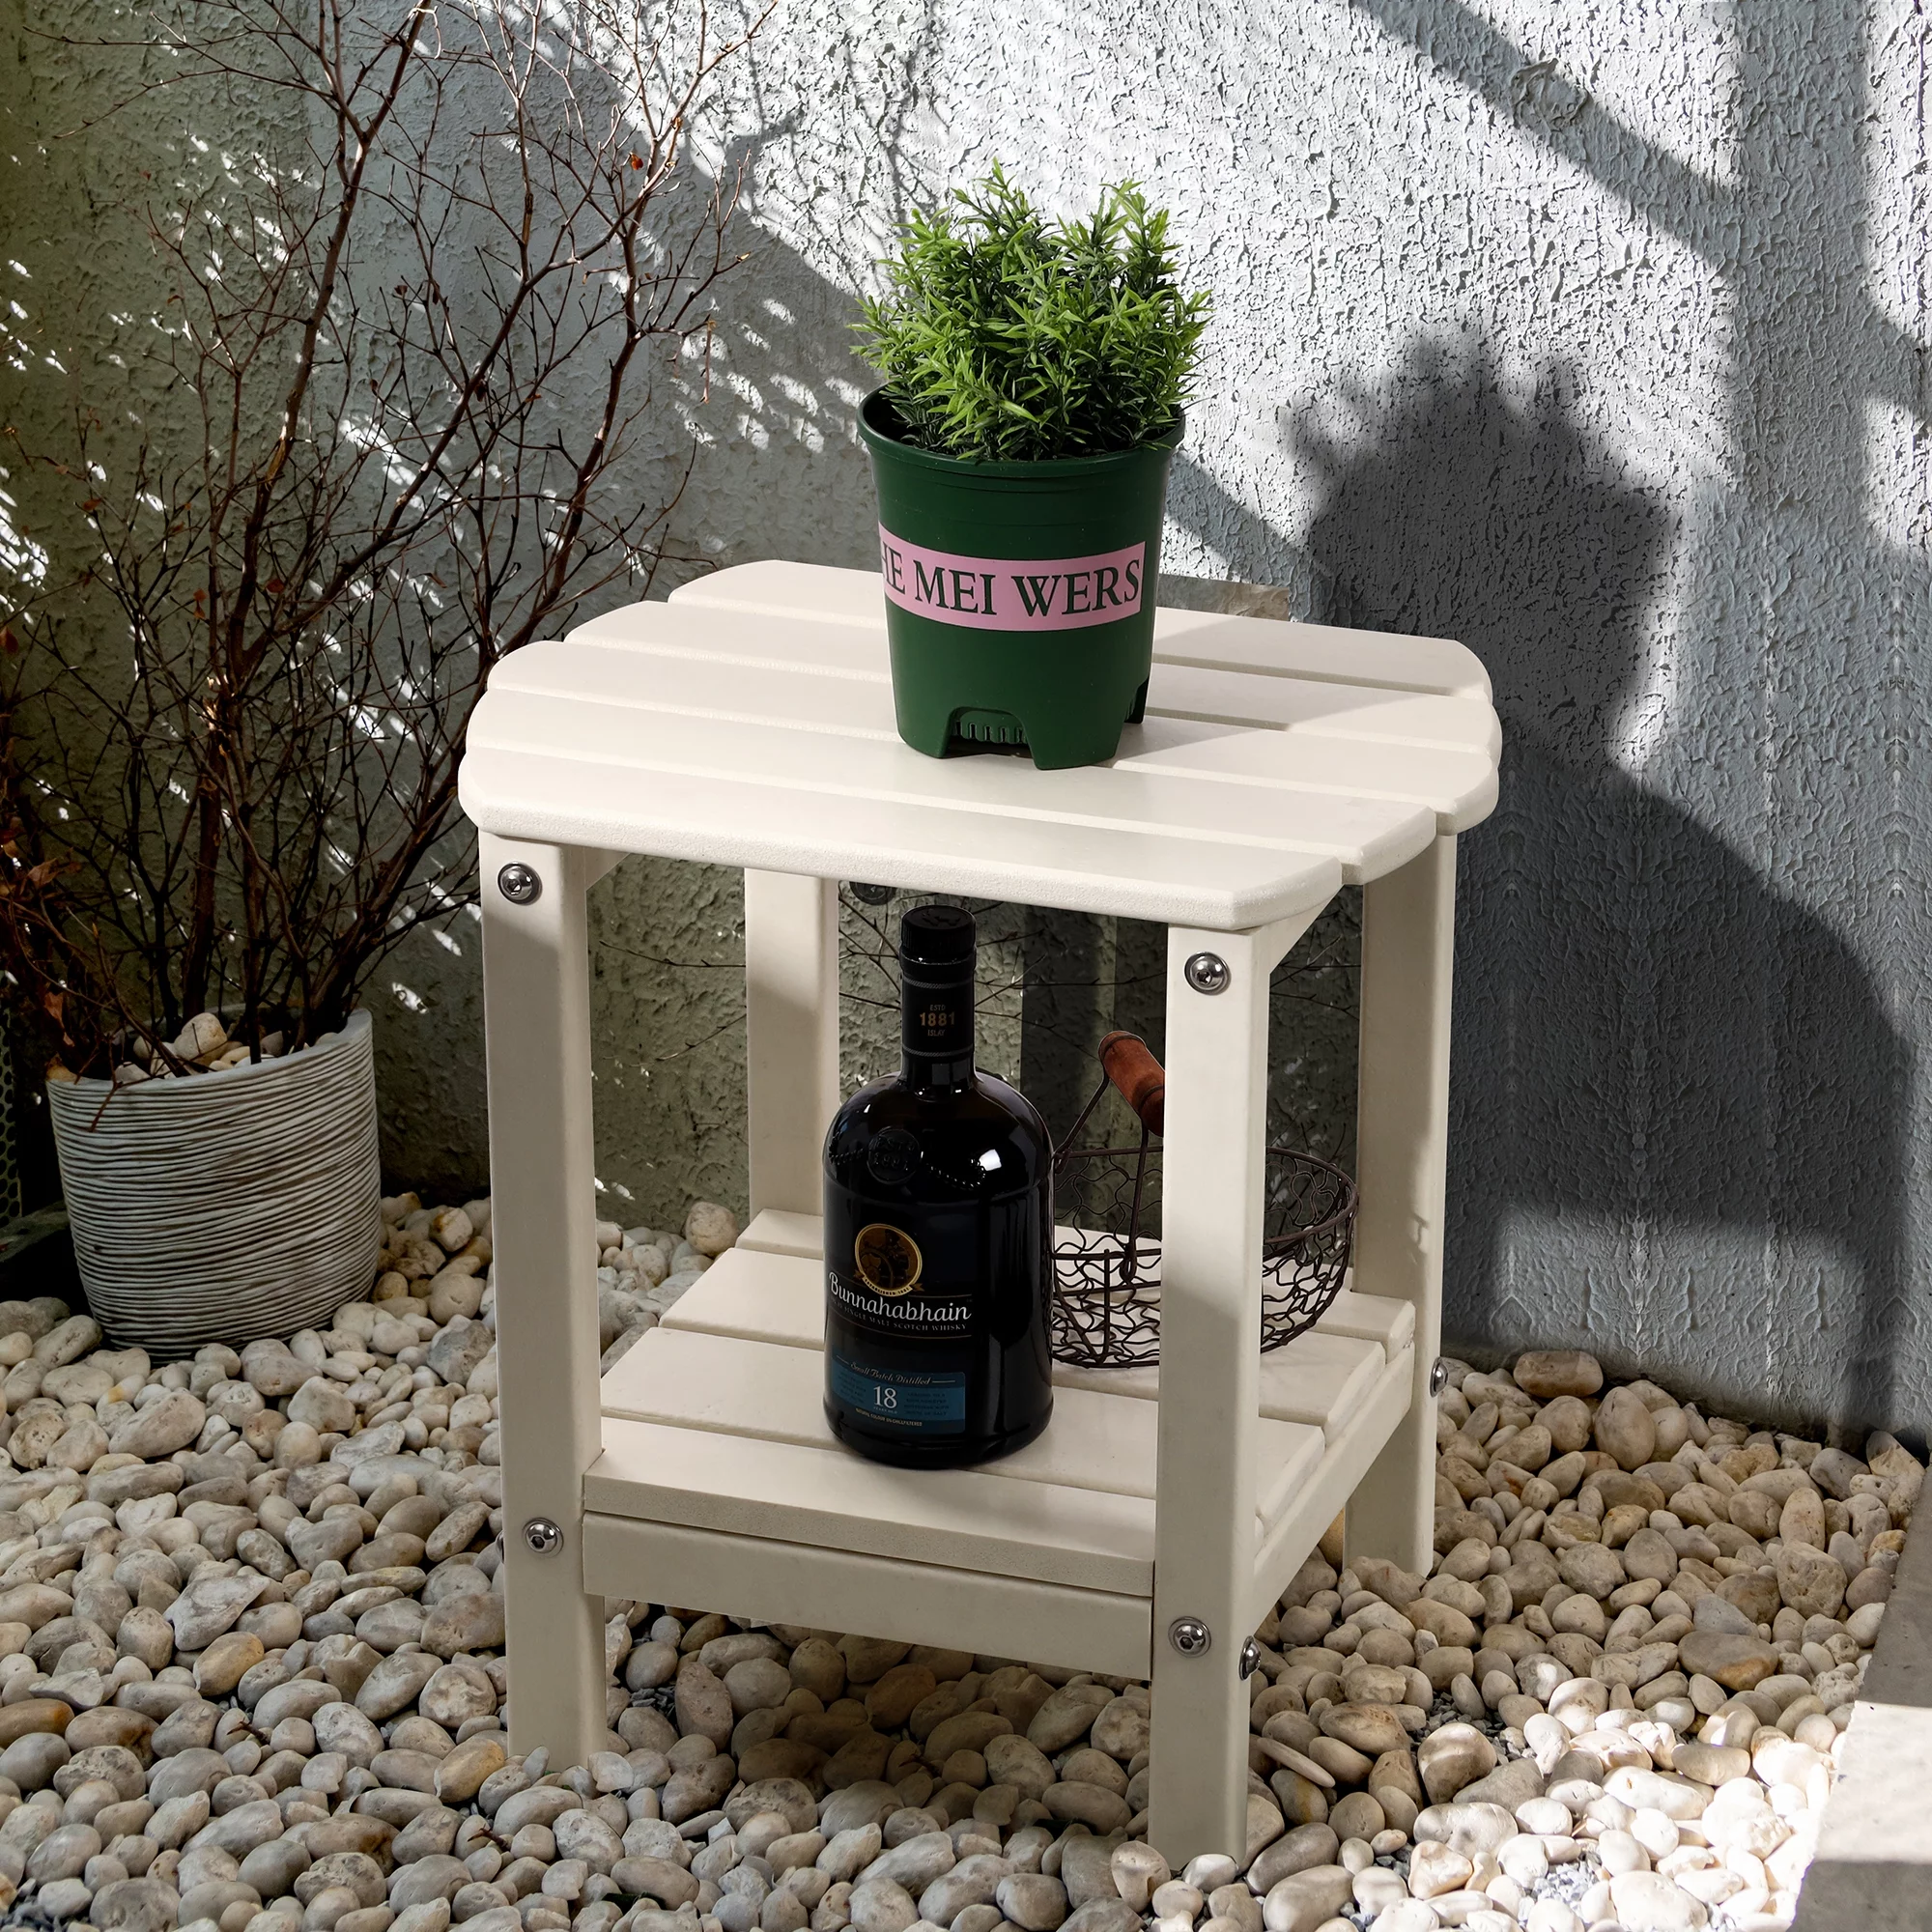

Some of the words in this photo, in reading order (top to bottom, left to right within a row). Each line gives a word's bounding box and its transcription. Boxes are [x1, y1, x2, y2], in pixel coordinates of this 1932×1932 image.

[912, 558, 998, 616] MEI
[1009, 557, 1141, 617] WERS
[919, 1011, 955, 1027] 1881
[829, 1271, 972, 1321] Bunnahabhain
[869, 1316, 890, 1327] MALT
[894, 1322, 928, 1331] SCOTCH
[932, 1322, 967, 1331] WHISKY
[850, 1361, 870, 1376] Small
[870, 1368, 894, 1381] Batch
[895, 1374, 931, 1385] Distilled
[873, 1385, 897, 1409] 18
